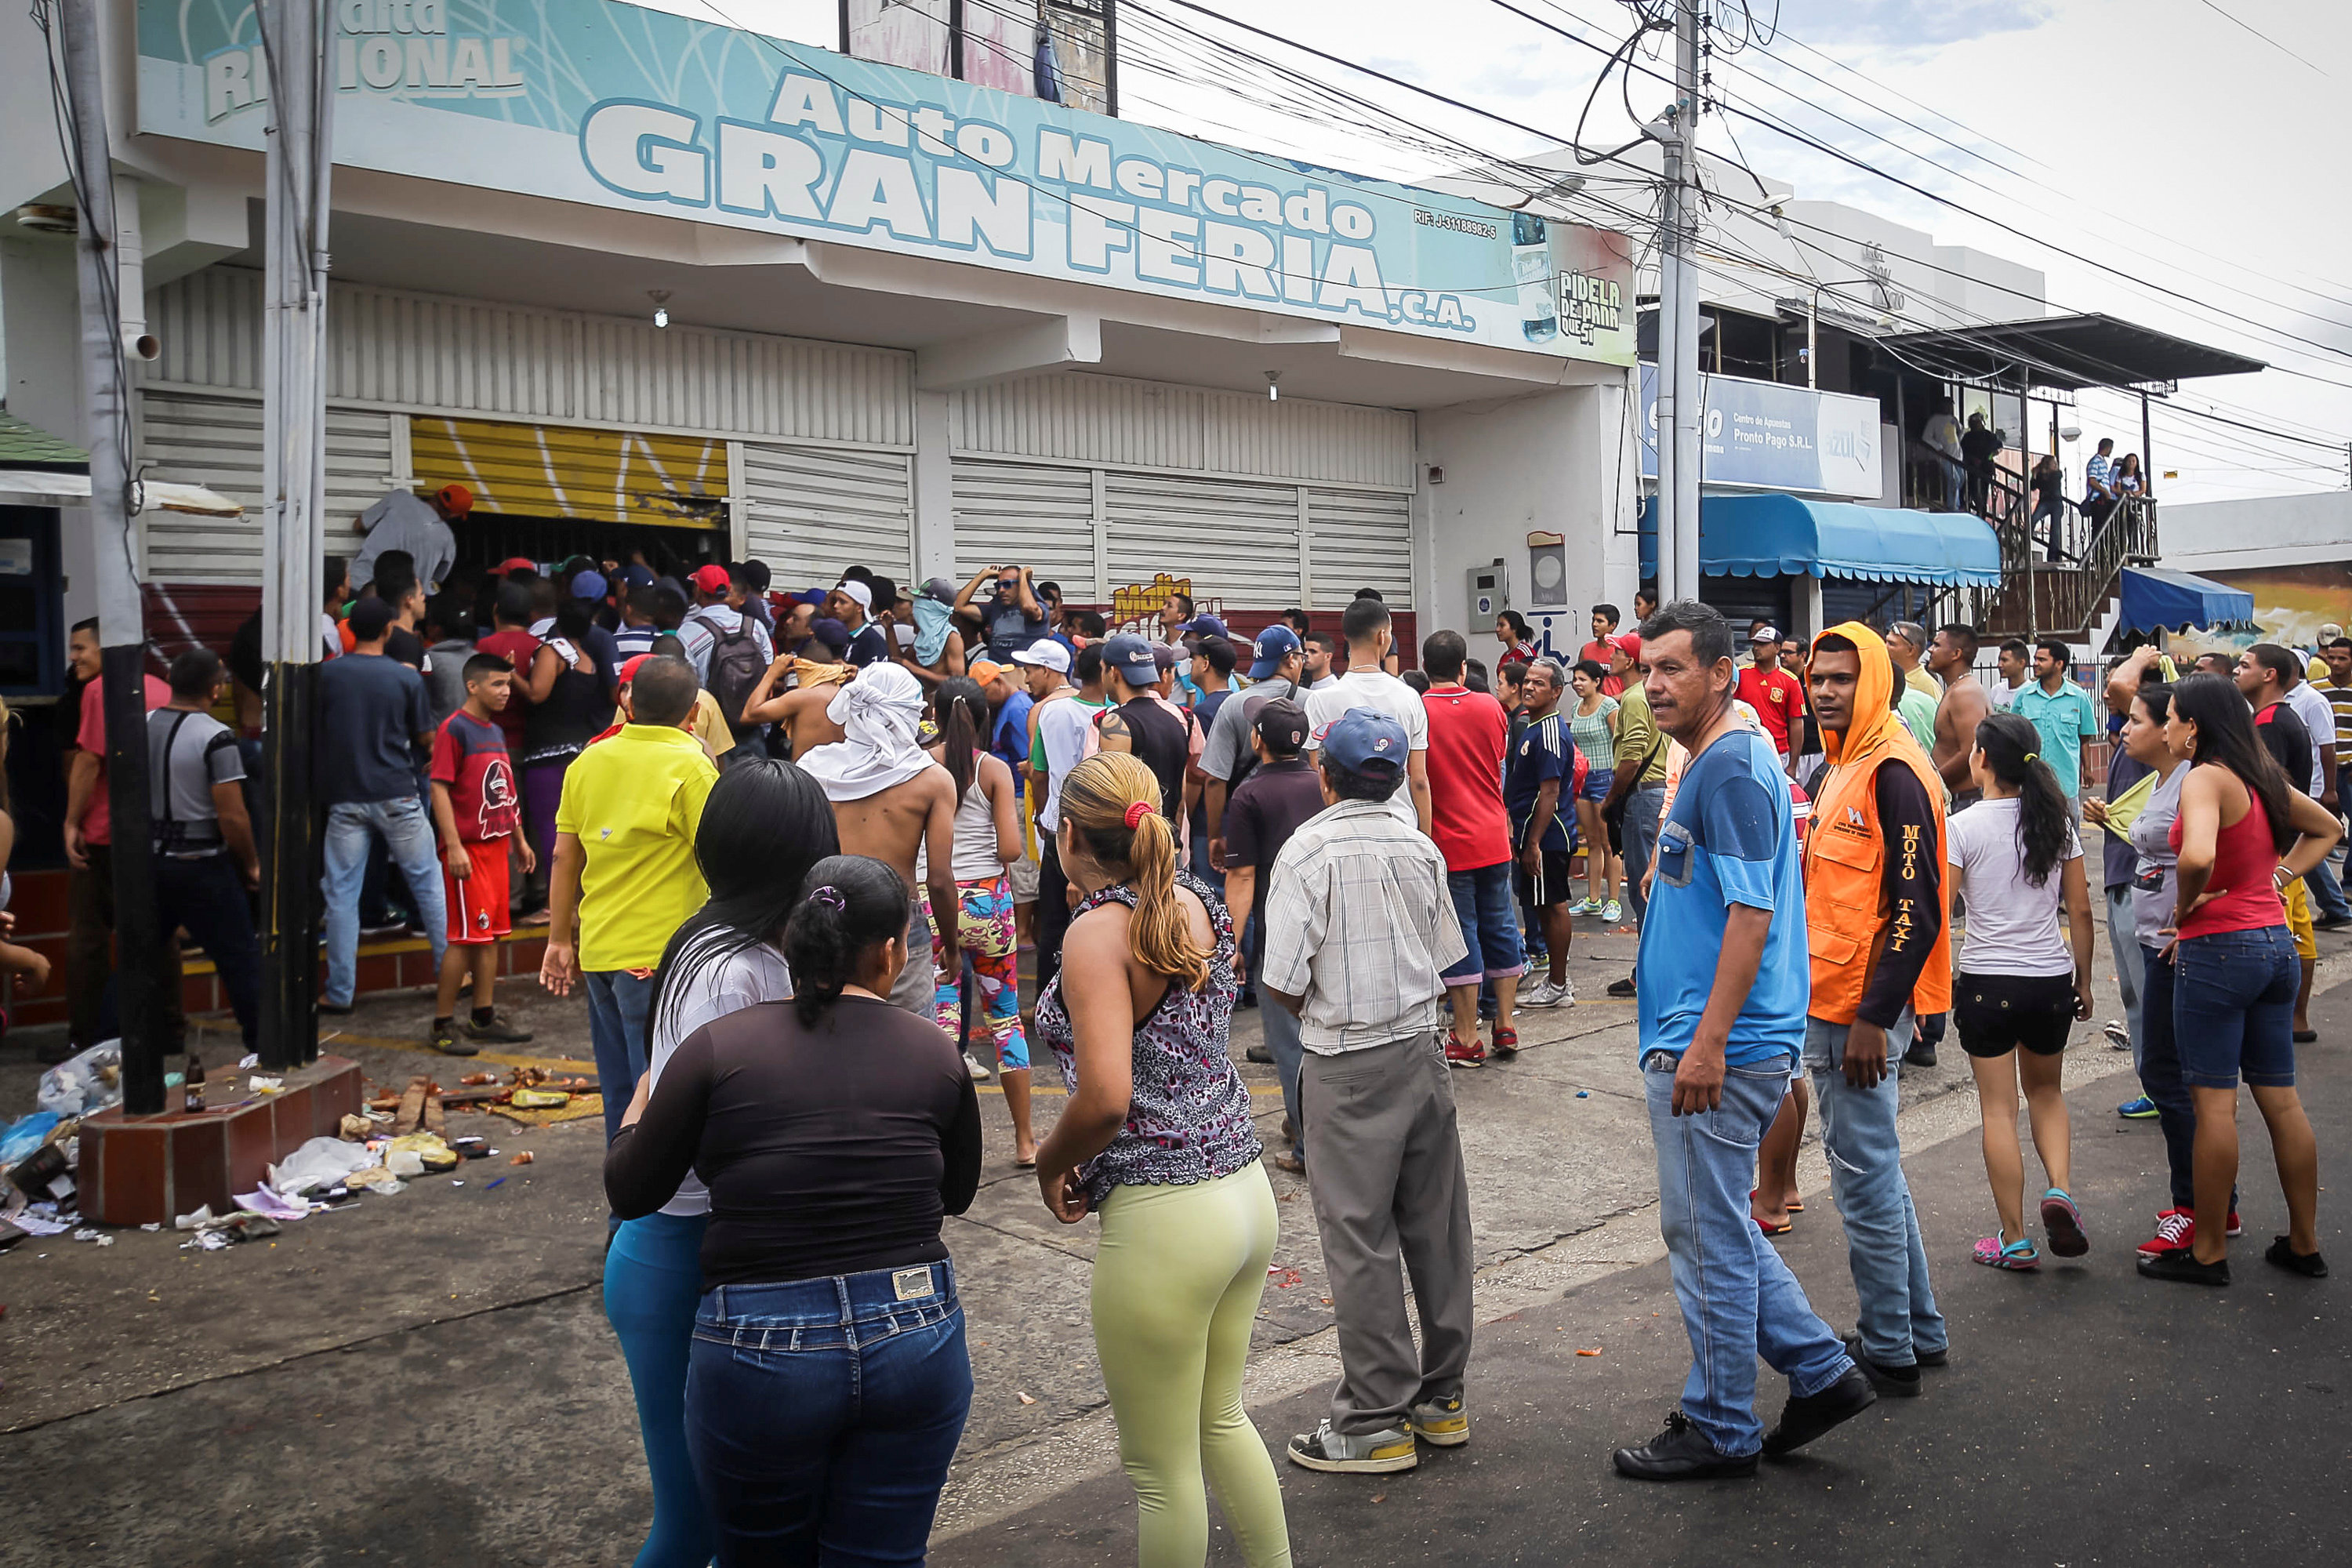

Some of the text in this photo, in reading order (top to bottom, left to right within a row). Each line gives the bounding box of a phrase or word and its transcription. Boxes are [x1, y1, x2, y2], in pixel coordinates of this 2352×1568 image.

[205, 36, 524, 122] RIONAL
[582, 100, 1032, 259] GRAN
[768, 69, 1374, 241] Auto Mercado
[1414, 209, 1497, 239] RIF: J-31188982-5
[1733, 412, 1791, 430] Centro de Apuestas
[1733, 428, 1763, 444] Pronto
[1766, 432, 1787, 449] Pago
[1789, 434, 1813, 450] S.R.L.
[1901, 825, 1922, 880] MOTO
[1890, 898, 1914, 953] TAXI
